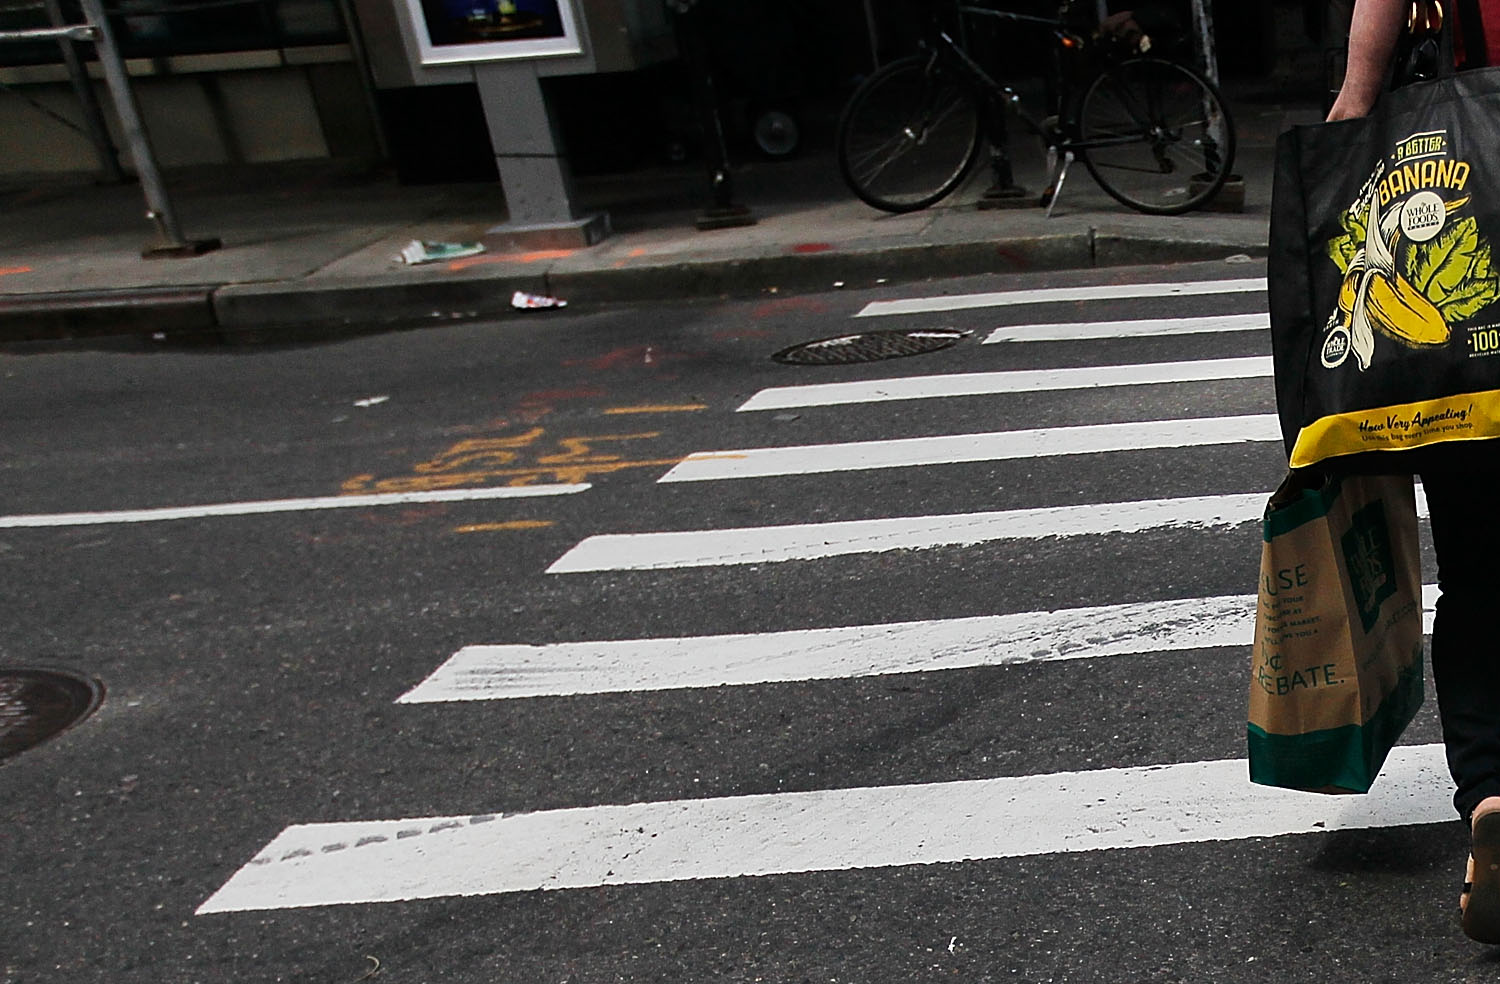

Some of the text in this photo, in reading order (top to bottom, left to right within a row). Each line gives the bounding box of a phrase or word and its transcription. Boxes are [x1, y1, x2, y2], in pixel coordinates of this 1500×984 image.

[1397, 136, 1442, 160] A BETTER
[1378, 159, 1470, 207] BANANA
[1406, 203, 1440, 217] WHOLE
[1408, 212, 1439, 227] FOODS
[1359, 403, 1473, 433] How Very Appealing!
[1442, 424, 1455, 433] you
[1455, 421, 1473, 430] shop
